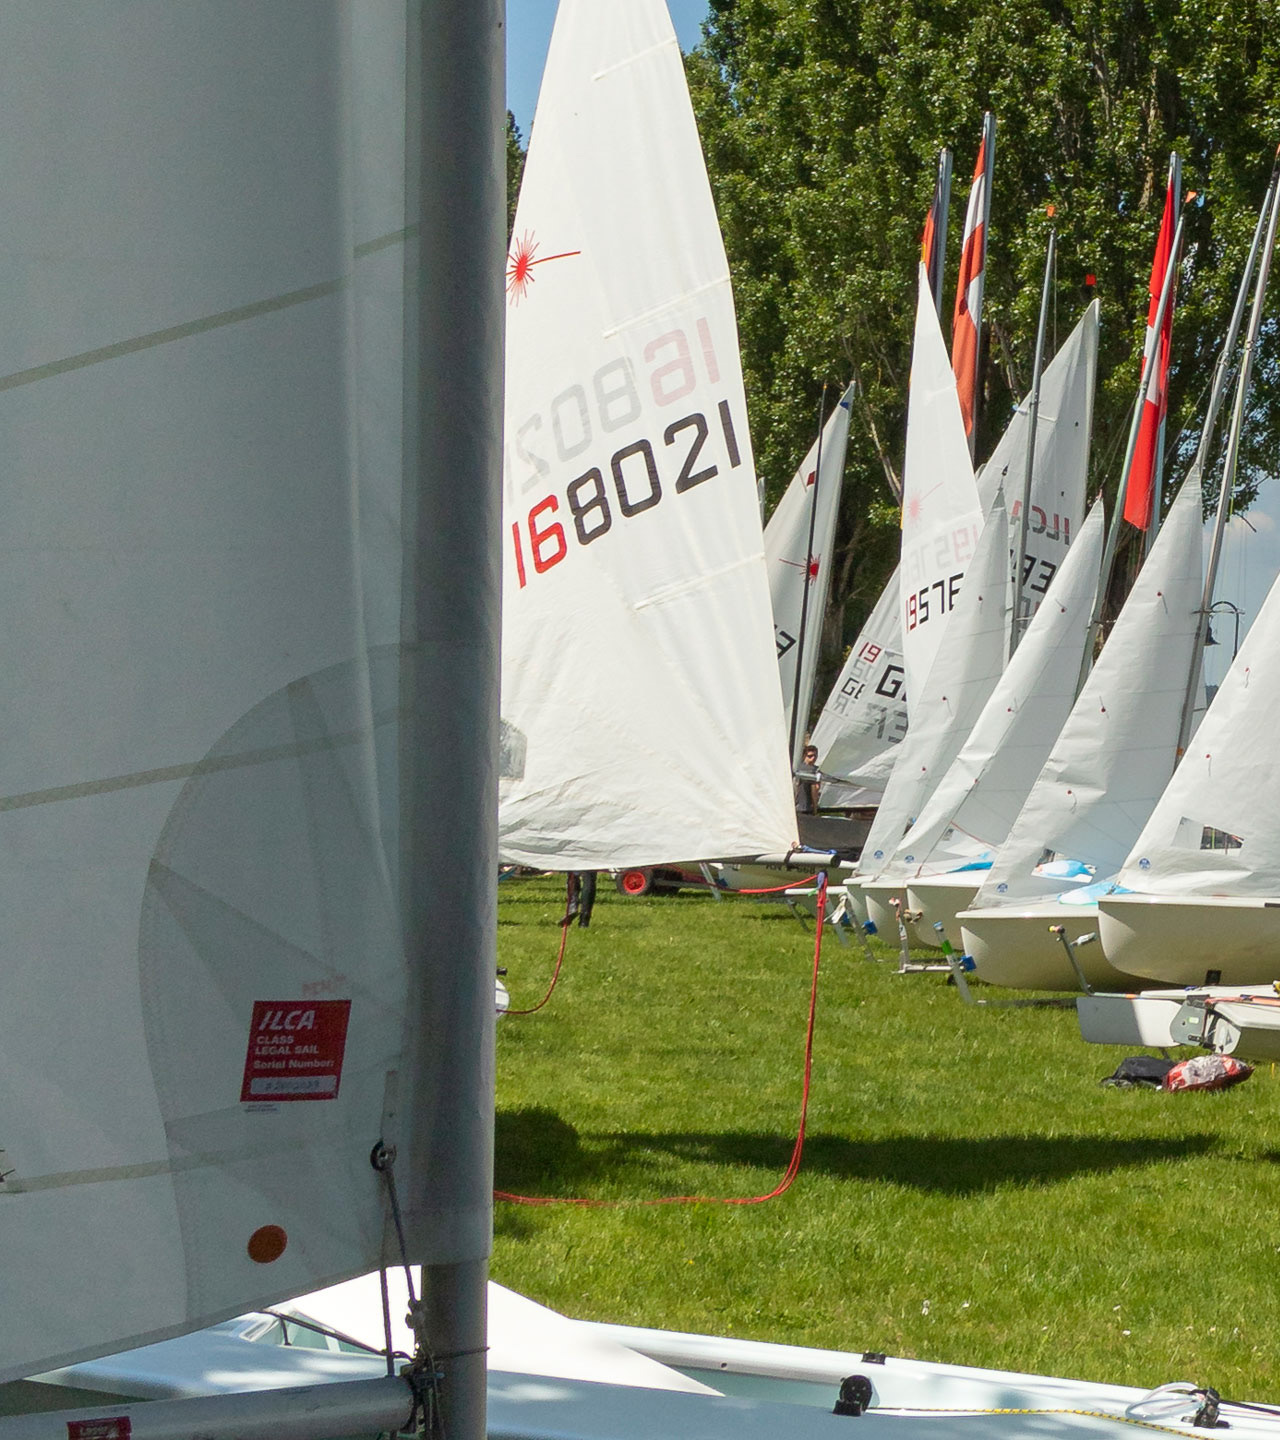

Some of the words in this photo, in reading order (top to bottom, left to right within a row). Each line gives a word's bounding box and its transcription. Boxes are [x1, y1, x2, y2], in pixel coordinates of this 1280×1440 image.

[512, 399, 742, 589] 168021
[258, 1009, 316, 1031] ILCA
[256, 1035, 294, 1045] CLASS
[255, 1045, 291, 1055] LEGAL
[294, 1044, 319, 1054] SAIL
[253, 1060, 285, 1069] Serial
[288, 1058, 334, 1069] Number:
